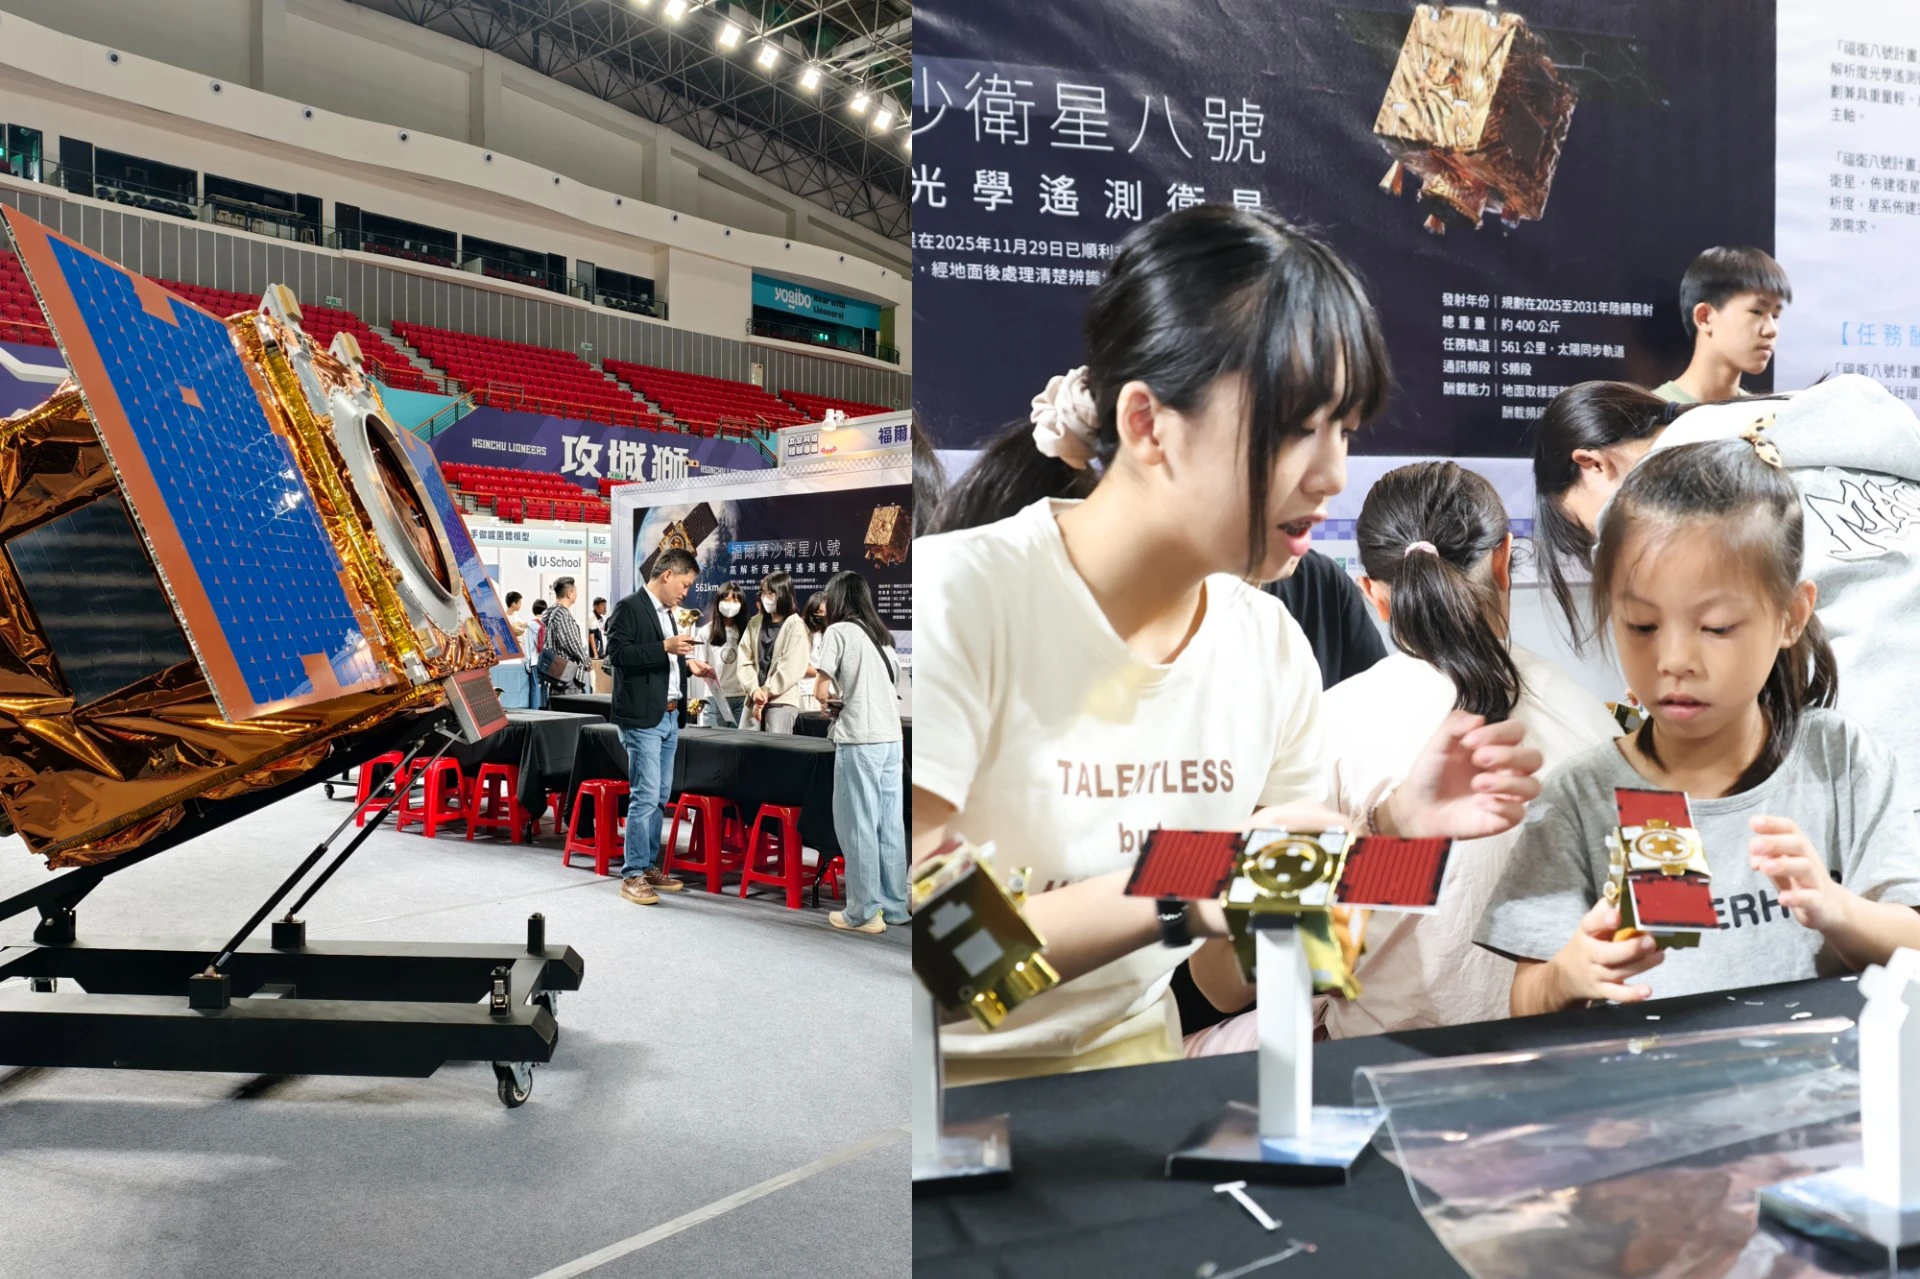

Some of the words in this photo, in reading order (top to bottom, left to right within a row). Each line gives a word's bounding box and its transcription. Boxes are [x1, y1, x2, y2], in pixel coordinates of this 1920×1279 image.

[1831, 84, 1920, 107] 劃兼具重量輕、
[1829, 196, 1920, 216] 析度，星系佈建
[774, 287, 812, 310] yogibo
[831, 299, 846, 309] with
[1441, 292, 1490, 309] 發射年份
[878, 424, 912, 445] 福爾
[471, 438, 507, 452] HSINCHU
[508, 442, 547, 456] LIONEERS
[561, 435, 689, 482] 攻城獅
[731, 539, 841, 560] 福爾摩沙衛星八號
[540, 556, 581, 568] U-School
